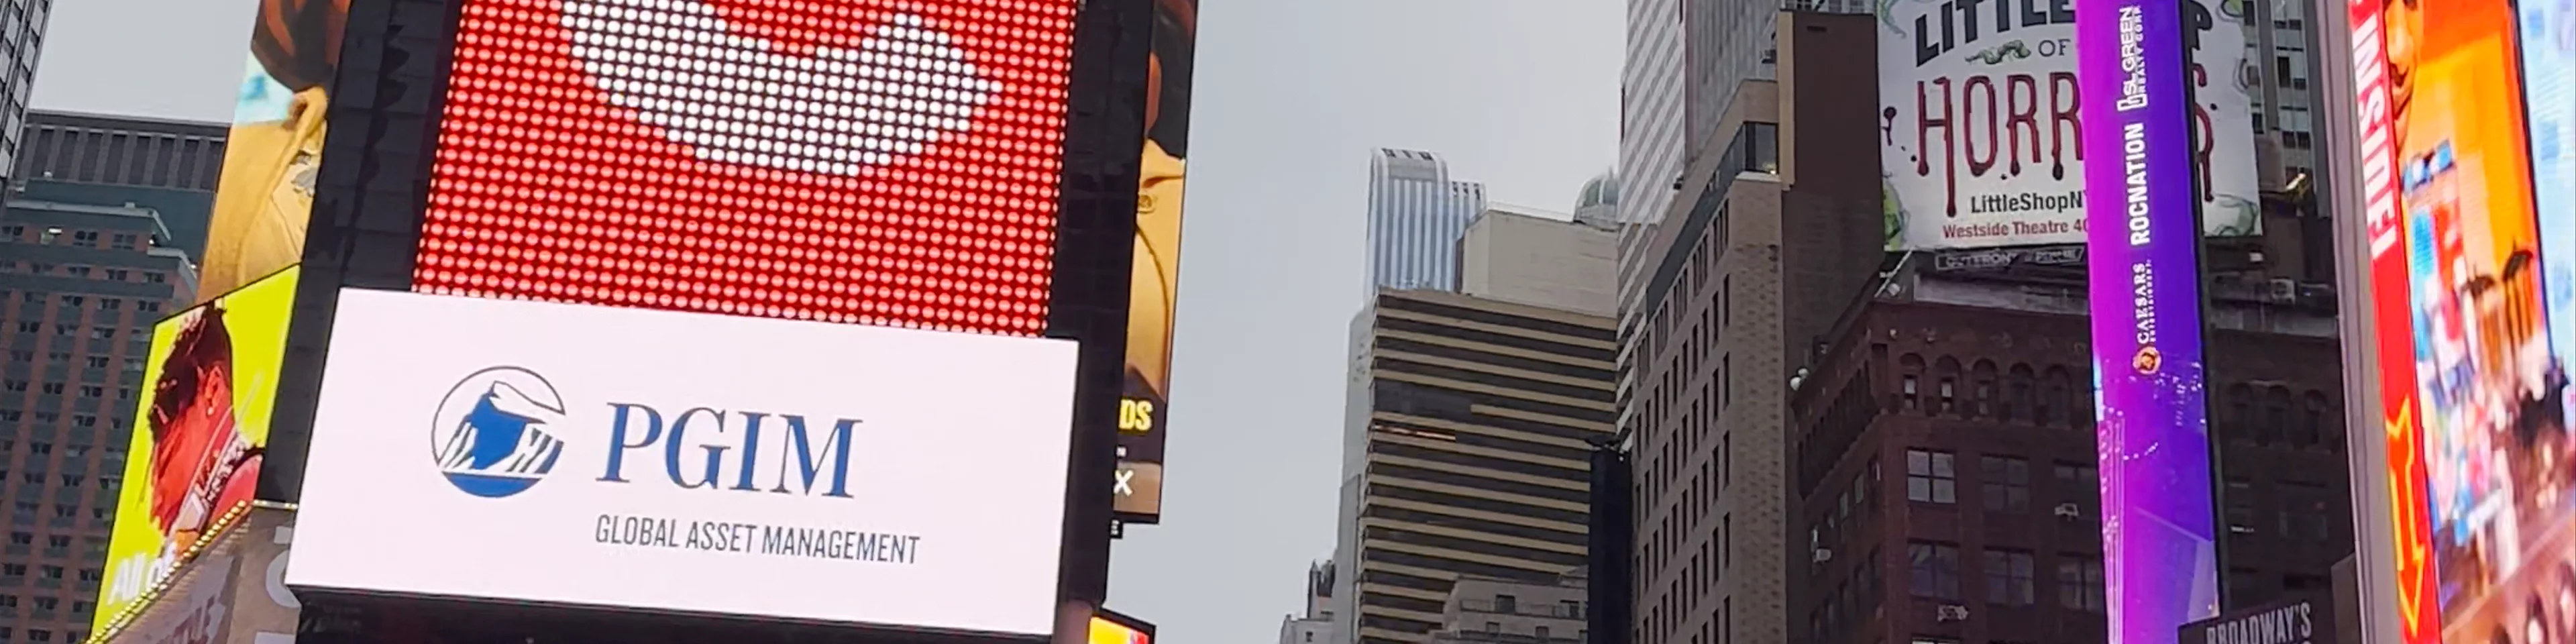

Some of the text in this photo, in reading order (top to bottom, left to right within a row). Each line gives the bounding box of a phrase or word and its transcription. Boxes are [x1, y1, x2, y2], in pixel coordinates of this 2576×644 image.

[1915, 0, 2076, 67] LITTLE
[2038, 38, 2070, 57] OF
[2118, 5, 2135, 72] GREEN
[1971, 190, 2090, 214] LittleShopN
[2125, 123, 2150, 246] ROCNATION
[1943, 221, 2009, 239] Westside
[2012, 219, 2069, 235] Theatre
[2133, 263, 2149, 344] CAESARS
[596, 402, 863, 498] PGIM
[596, 514, 921, 564] GLOBAL ASSET MANAGEMENT
[2206, 602, 2312, 644] BROADWAY'S
